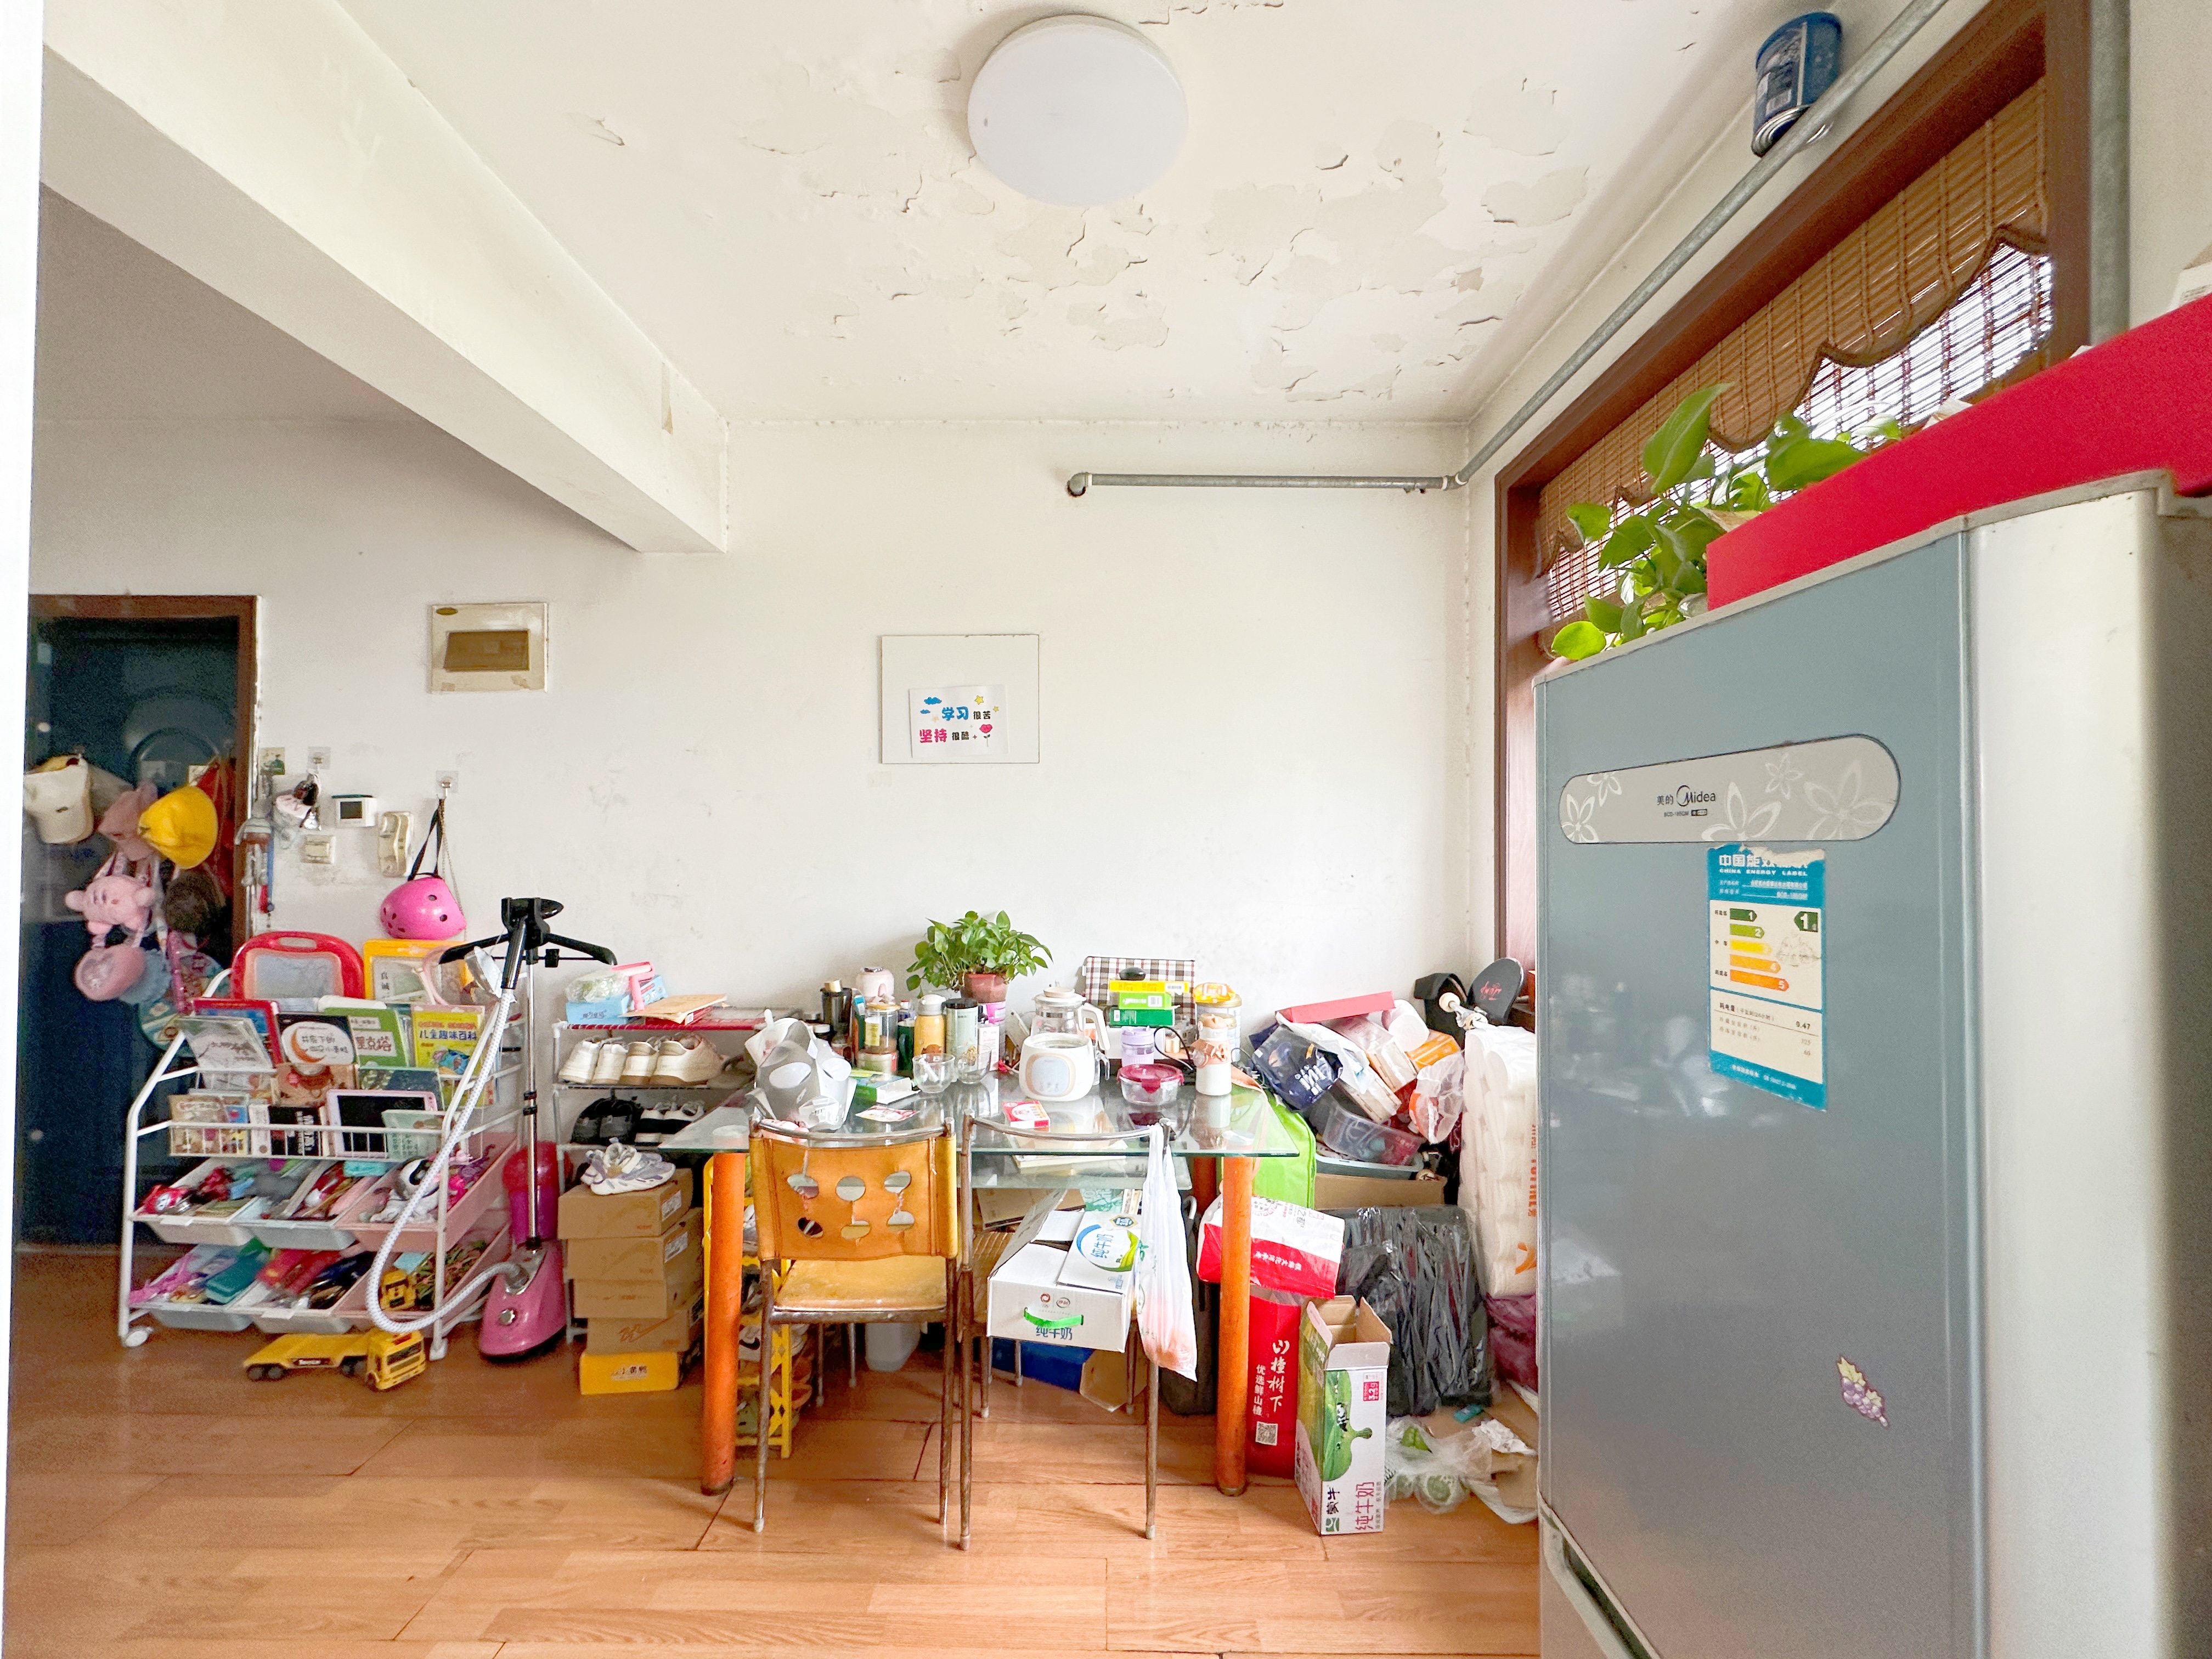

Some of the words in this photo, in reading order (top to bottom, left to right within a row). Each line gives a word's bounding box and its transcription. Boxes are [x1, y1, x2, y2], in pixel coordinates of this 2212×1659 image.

[941, 706, 969, 721] 学习
[973, 711, 991, 720] 很苦
[919, 729, 947, 743] 坚持
[952, 731, 969, 741] 很酷
[1657, 794, 1674, 805] 美的
[1676, 785, 1716, 807] Midea
[1748, 911, 1753, 921] 1
[1800, 913, 1809, 929] 1
[1754, 928, 1762, 937] 2
[1770, 963, 1777, 972] 4
[1779, 980, 1785, 989] 5
[1796, 1021, 1811, 1030] 0.47
[419, 1029, 477, 1041] 儿童趣味百科
[1091, 1233, 1114, 1259] 纯牛奶
[1267, 1339, 1290, 1413] 山楂树下
[1252, 1364, 1266, 1416] 优选鲜山楂
[1327, 1486, 1340, 1515] 蒙牛
[1355, 1482, 1375, 1530] 纯牛奶
